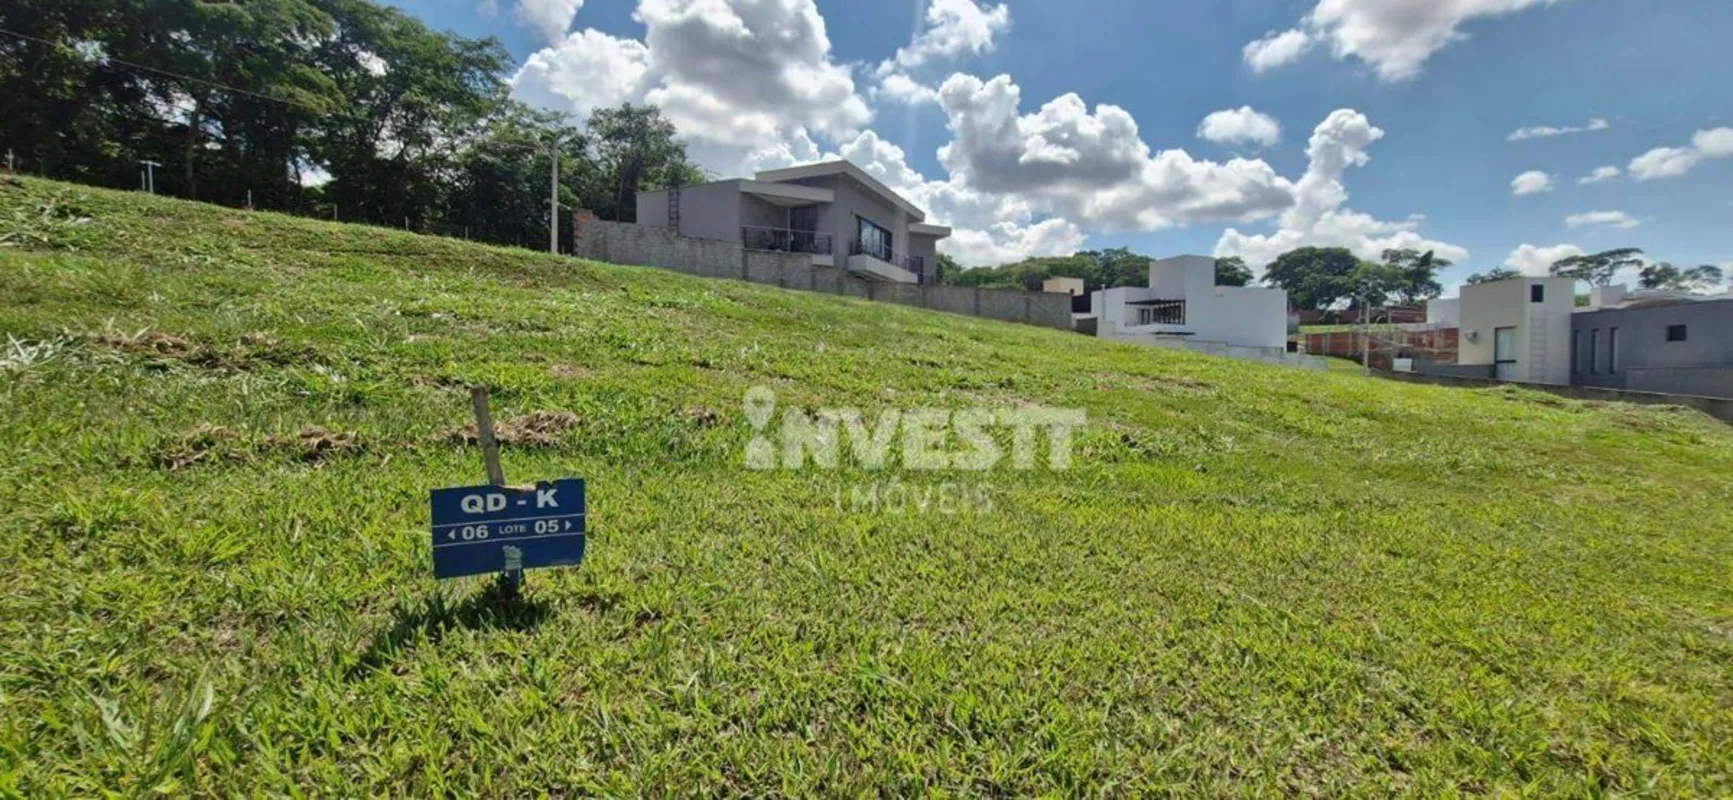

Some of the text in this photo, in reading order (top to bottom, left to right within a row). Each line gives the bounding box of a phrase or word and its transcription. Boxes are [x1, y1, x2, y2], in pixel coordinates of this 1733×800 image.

[460, 493, 507, 514] QD
[536, 489, 559, 508] K
[461, 519, 560, 540] 06 LOTE 05
